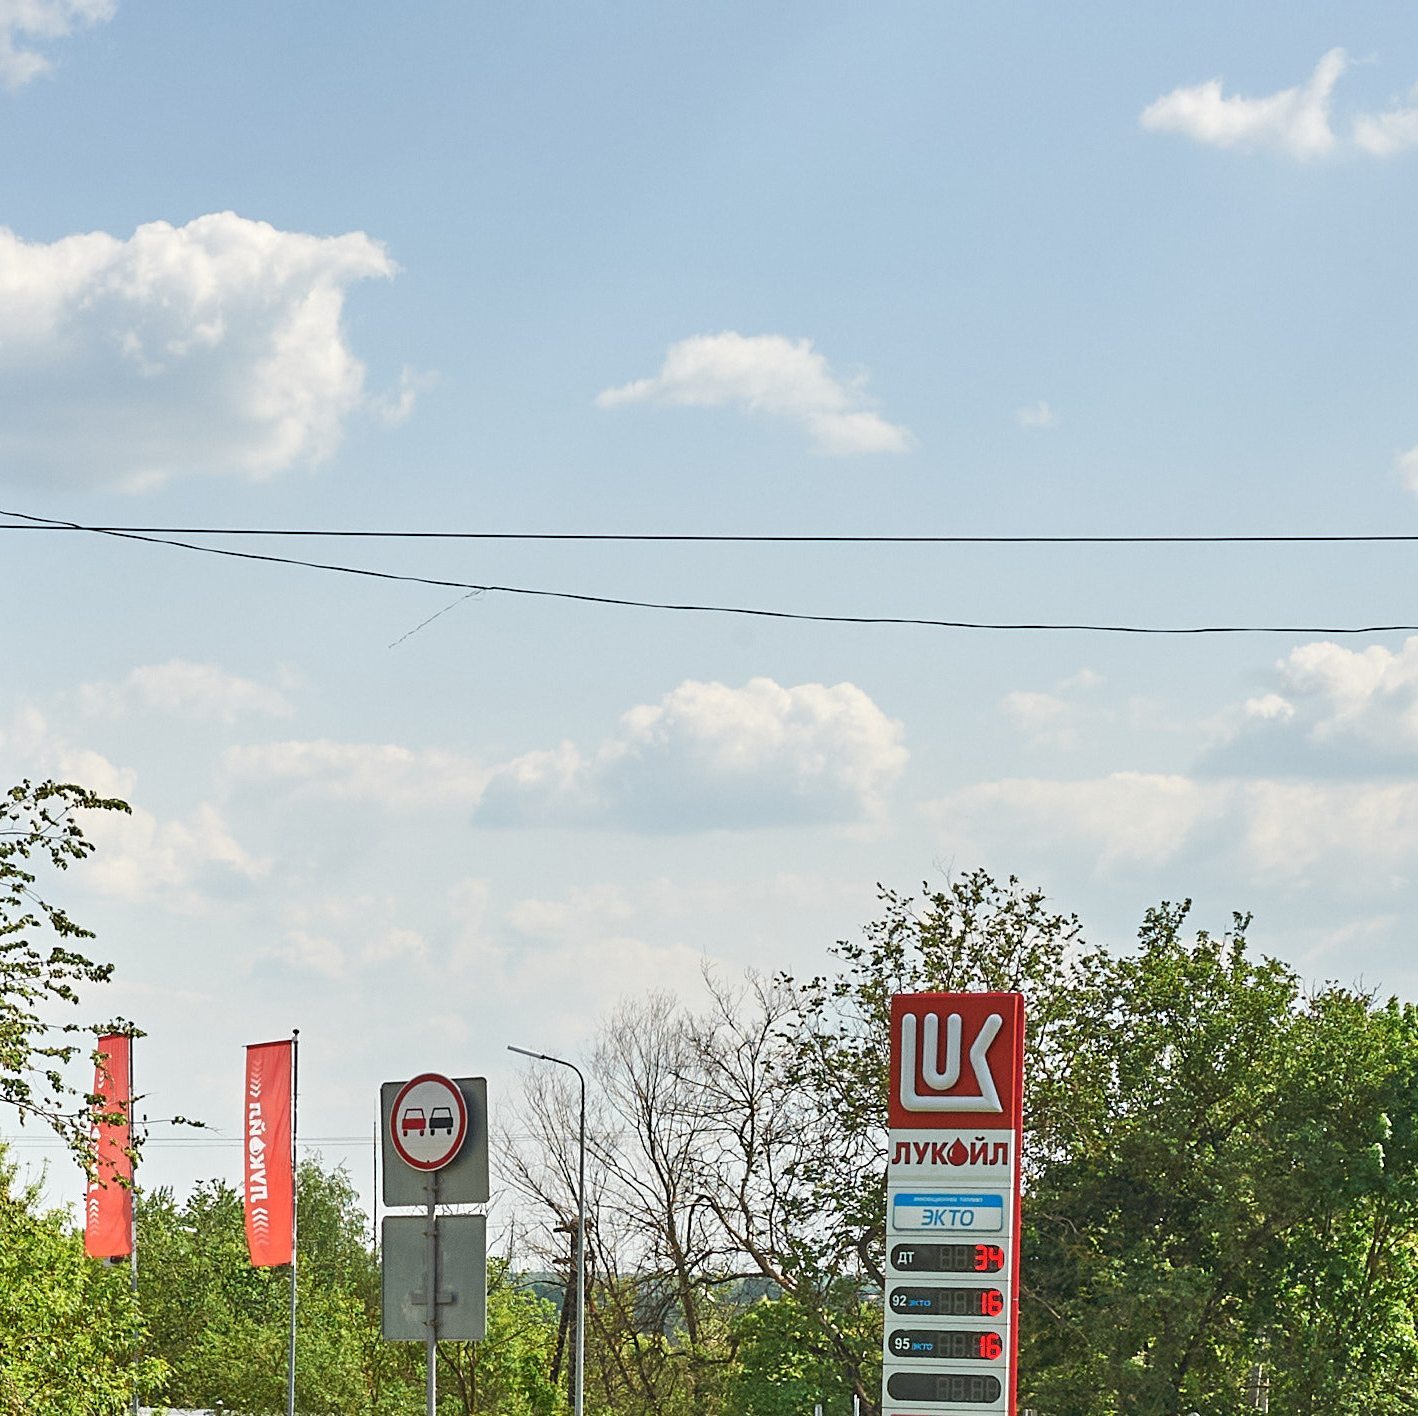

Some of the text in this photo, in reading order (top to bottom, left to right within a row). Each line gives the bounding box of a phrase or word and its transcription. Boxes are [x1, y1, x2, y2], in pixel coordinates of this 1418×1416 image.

[892, 1137, 1009, 1166] ЛУКОЙЛ
[921, 1209, 975, 1226] ЭКТО
[897, 1251, 914, 1264] ДТ
[892, 1295, 907, 1307] 92
[895, 1338, 910, 1350] 95
